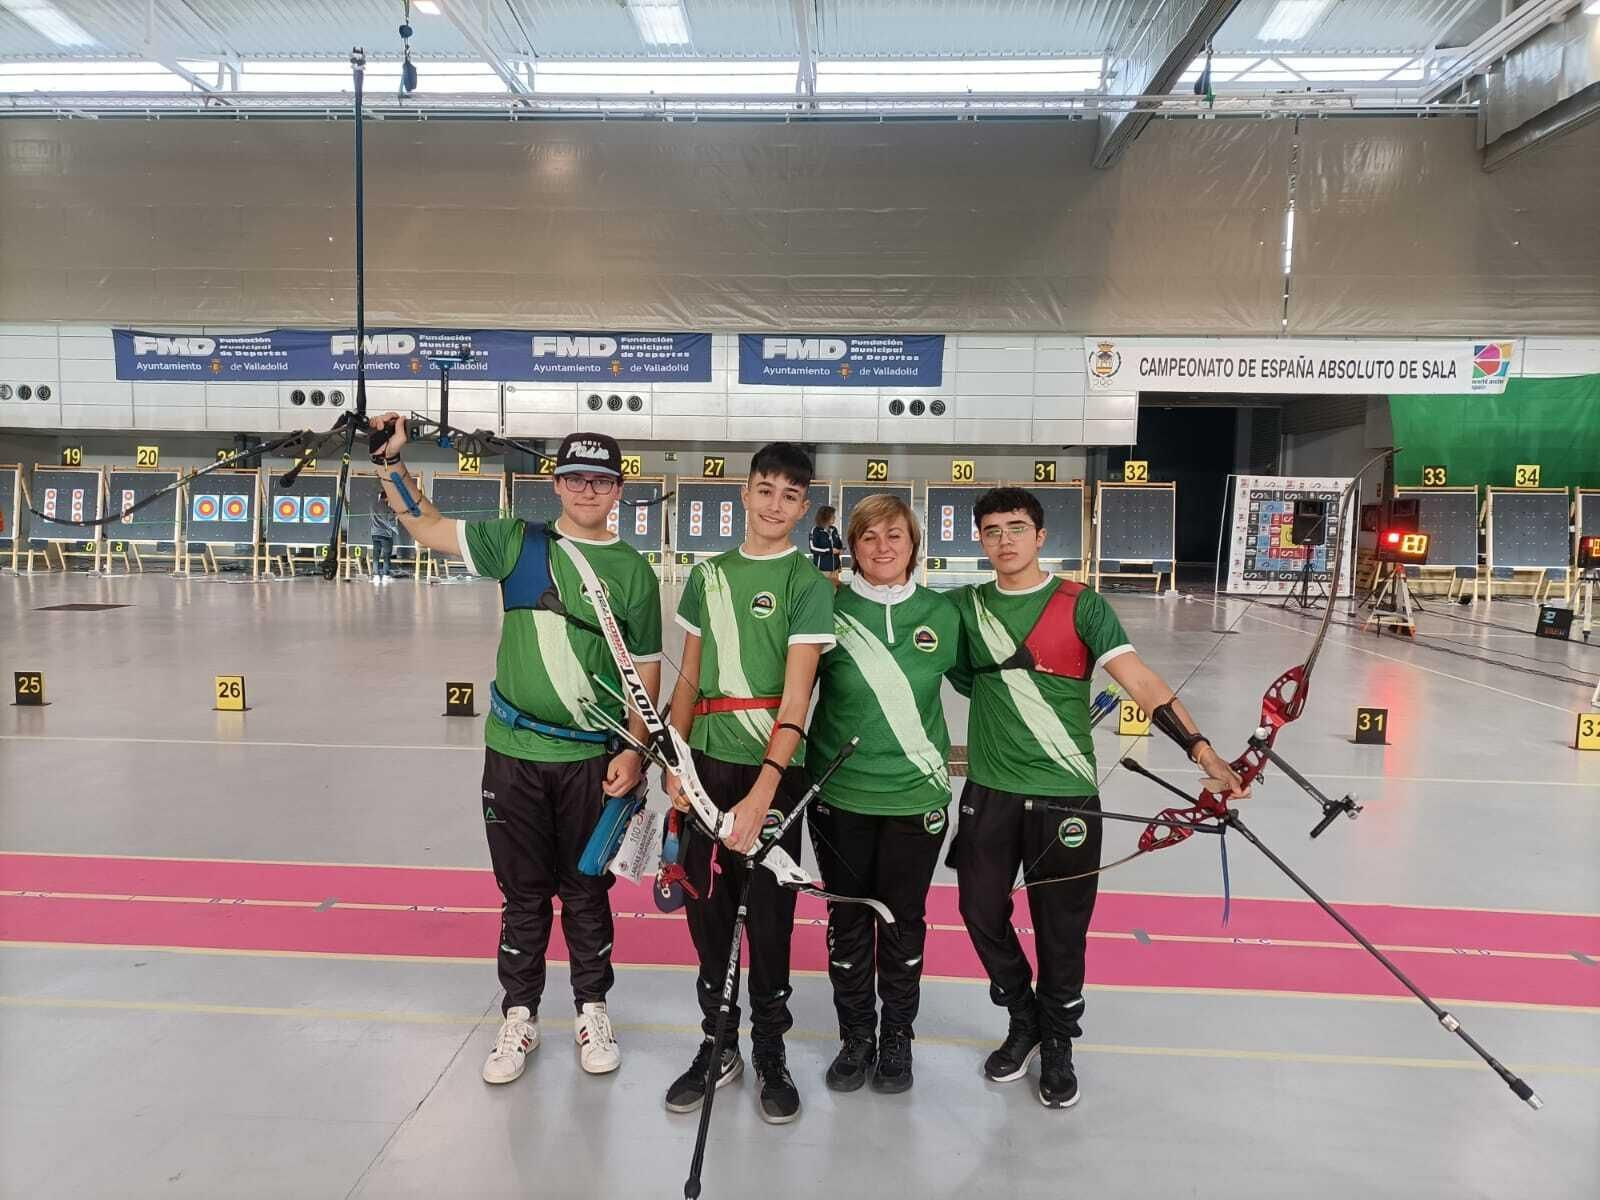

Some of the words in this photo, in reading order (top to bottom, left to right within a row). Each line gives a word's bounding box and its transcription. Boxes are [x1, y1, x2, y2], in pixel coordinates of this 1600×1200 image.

[134, 336, 216, 357] FMD
[331, 334, 416, 356] FMD
[532, 336, 617, 357] FMD
[763, 338, 847, 360] FMD
[136, 361, 202, 372] Ayuntamiento
[230, 362, 242, 371] de
[243, 361, 288, 371] Valladolid
[447, 362, 488, 370] lladolid
[533, 363, 601, 373] Ayuntamiento
[630, 364, 642, 372] de
[643, 363, 689, 372] Valladolid
[763, 366, 830, 377] Ayuntamiento
[859, 367, 871, 376] de
[873, 367, 918, 376] Valladolid
[1139, 357, 1234, 378] CAMPEONATO
[1238, 358, 1257, 378] DE
[1261, 355, 1314, 379] ESPAÑA
[1318, 359, 1394, 379] ABSOLUTO
[1399, 360, 1418, 379] DE
[1422, 360, 1457, 379] SALA
[63, 449, 81, 465] 19
[138, 449, 157, 466] 20
[460, 457, 479, 473] 24
[622, 459, 640, 475] 26
[704, 459, 724, 475] 27
[867, 463, 888, 480] 29
[953, 463, 974, 480] 30
[1035, 463, 1055, 480] 31
[1125, 464, 1147, 481] 32
[1424, 468, 1446, 485] 33
[1517, 468, 1539, 485] 34
[18, 677, 41, 693] 25
[218, 681, 241, 698] 26
[449, 687, 472, 705] 27
[621, 665, 659, 726] HOYT
[1122, 706, 1147, 723] 30
[1358, 713, 1384, 731] 31
[1582, 719, 1600, 737] 3
